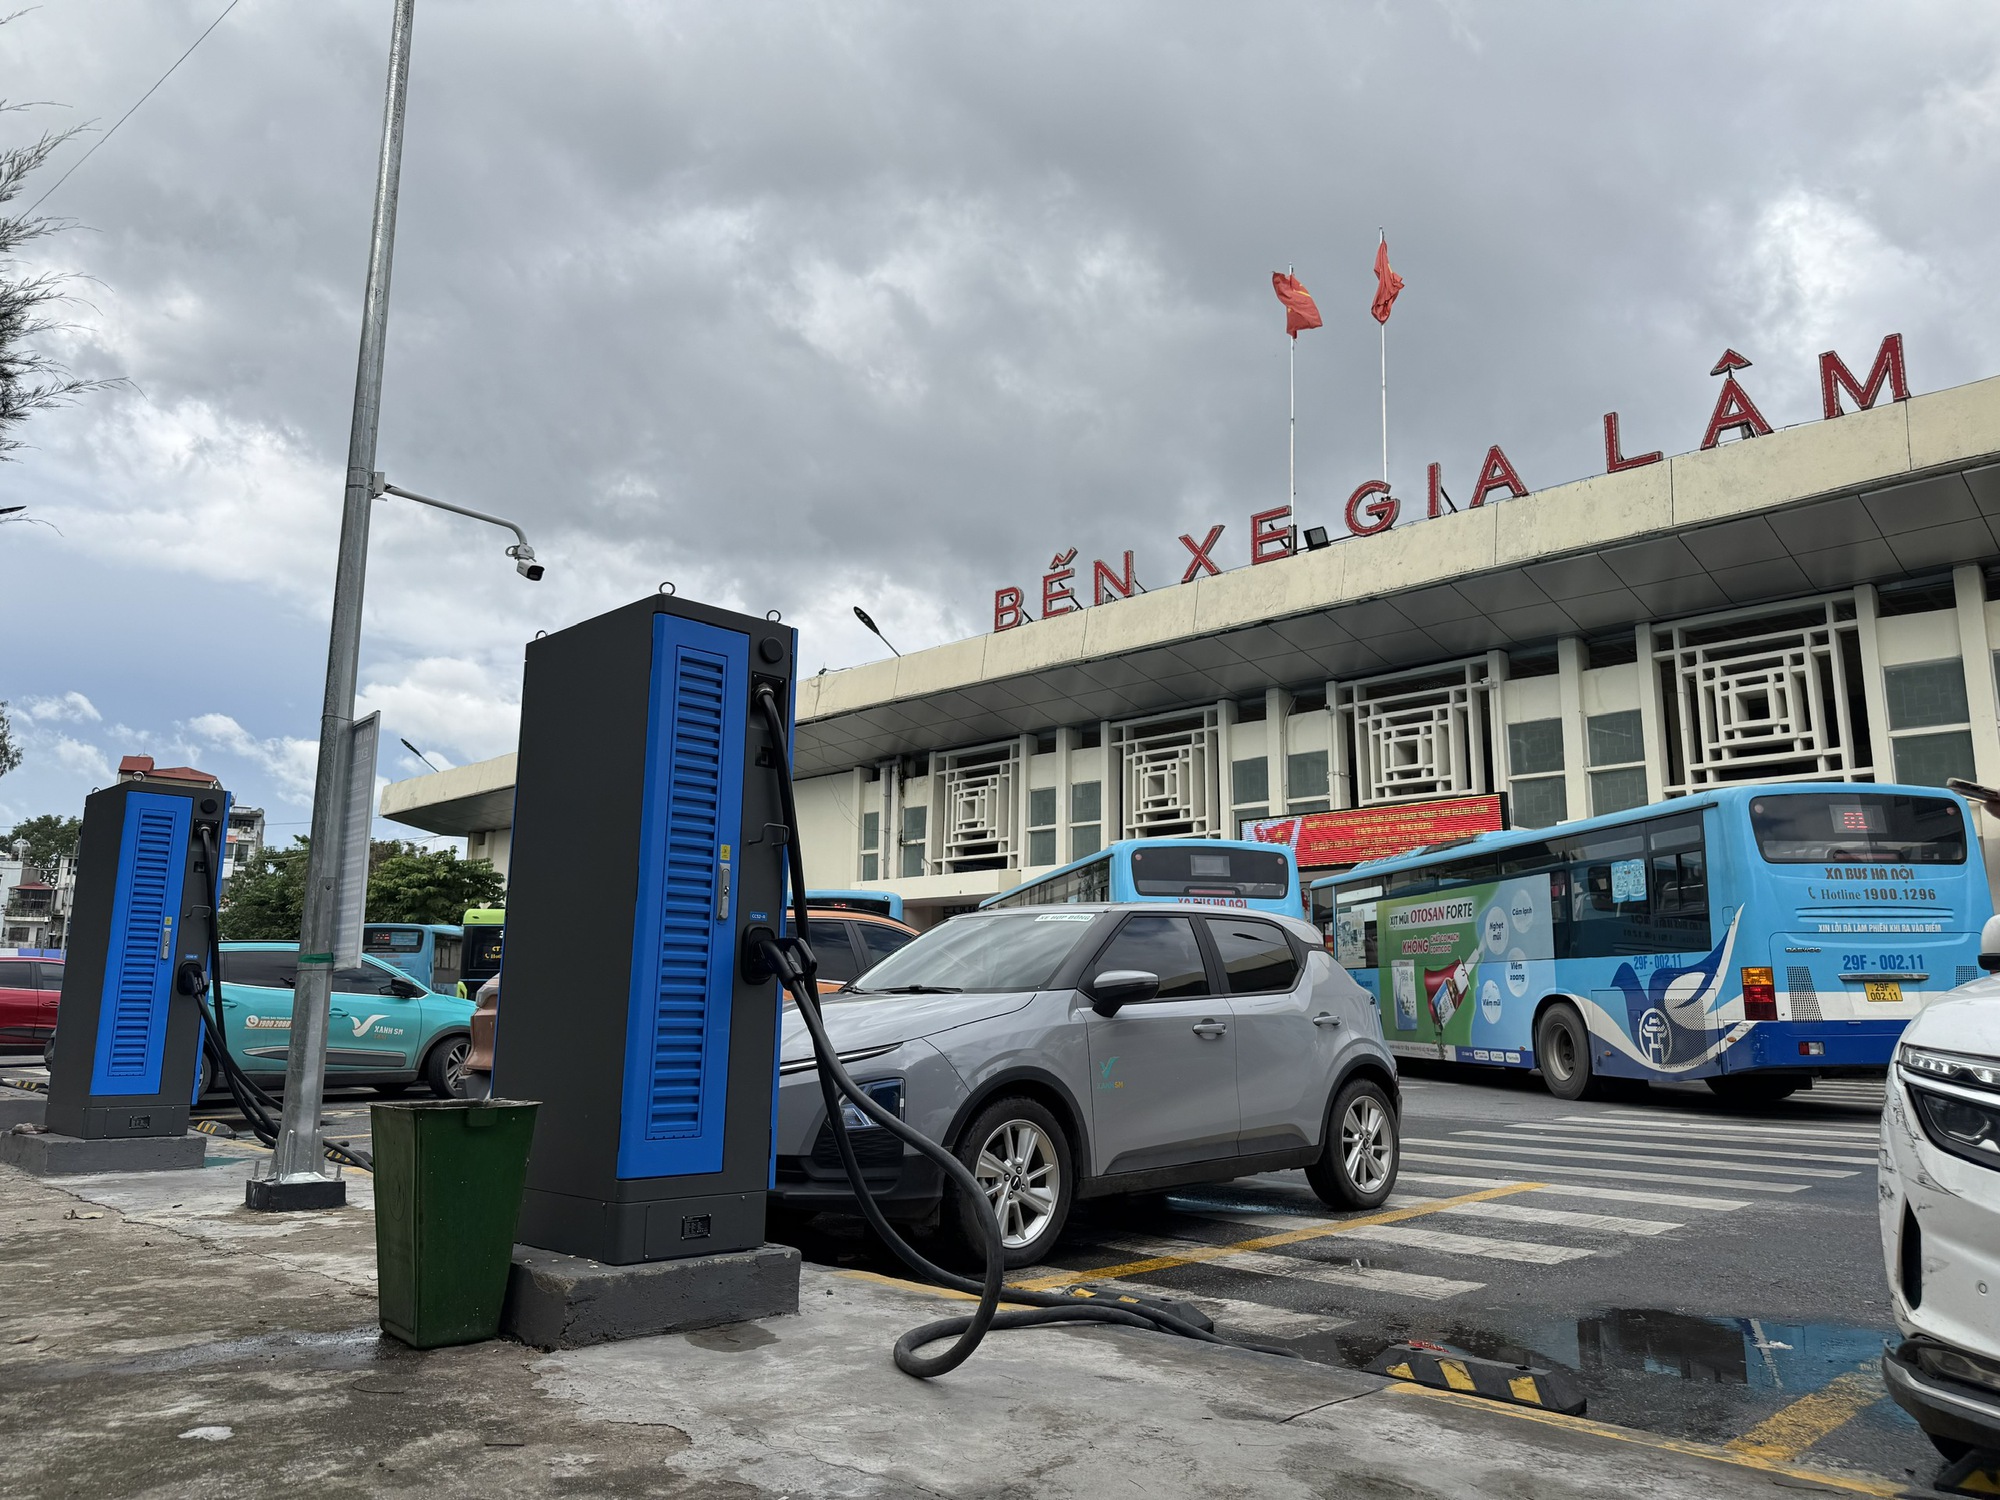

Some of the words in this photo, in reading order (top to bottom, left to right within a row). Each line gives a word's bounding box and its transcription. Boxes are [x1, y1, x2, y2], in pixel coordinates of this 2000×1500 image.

[994, 547, 1134, 632] BẾN
[1178, 504, 1293, 584] XE
[1344, 445, 1529, 537] GIA
[1604, 333, 1909, 474] LÂM
[1846, 868, 1867, 880] BUS
[1871, 865, 1888, 880] HÀ
[1891, 865, 1915, 883] NỘI
[1821, 888, 1861, 900] Hotline
[1863, 888, 1936, 900] 1900.1296
[1390, 915, 1399, 928] XỊT
[1399, 912, 1409, 925] MŨI
[1410, 906, 1445, 923] OTOSAN
[1446, 903, 1473, 919] FORTE
[1489, 922, 1504, 932] Nghẹt
[1818, 923, 1830, 933] XIN
[1889, 923, 1901, 933] KHI
[1901, 923, 1911, 933] RA
[1402, 935, 1429, 954] KHÔNG
[1634, 956, 1648, 970] 29F
[1654, 954, 1681, 968] 002.11
[1843, 955, 1867, 970] 29F
[1879, 954, 1924, 970] 002.11
[1509, 973, 1525, 982] xoang
[1874, 983, 1889, 991] 29F
[1870, 992, 1898, 1000] 002.11
[374, 1025, 394, 1034] XANH
[393, 1028, 404, 1036] SM
